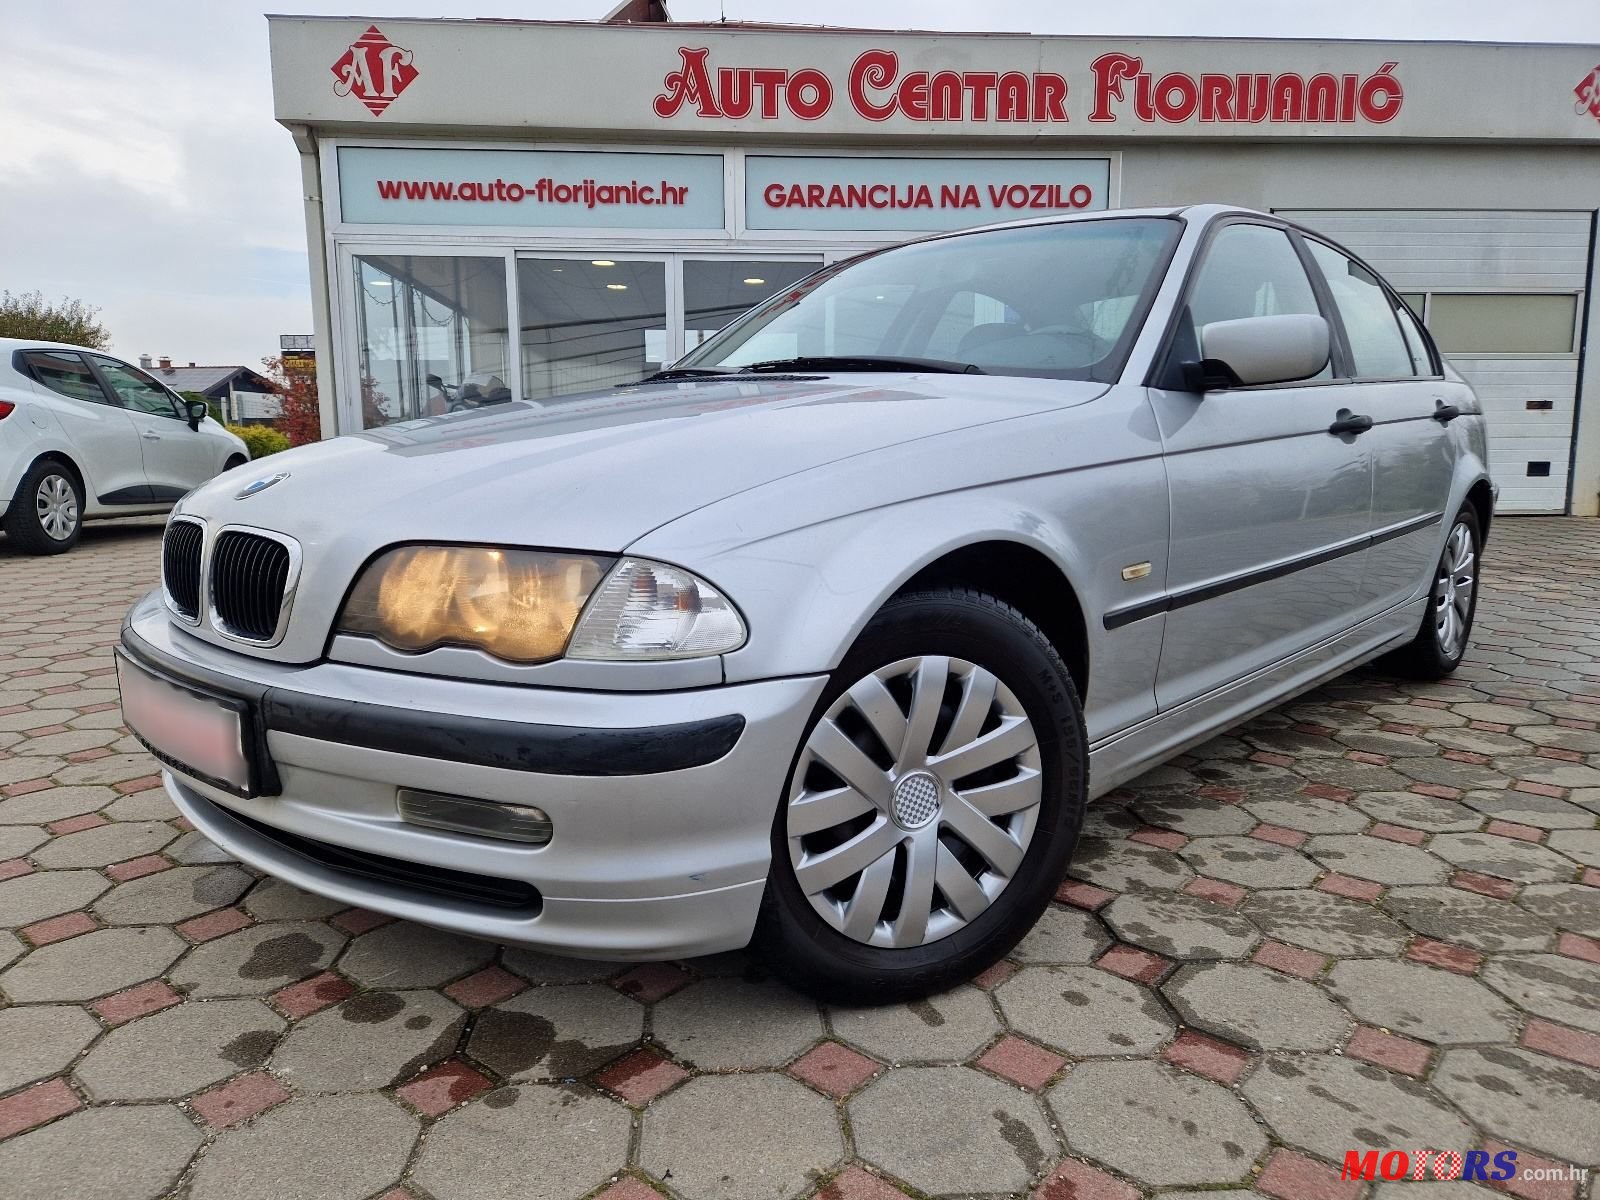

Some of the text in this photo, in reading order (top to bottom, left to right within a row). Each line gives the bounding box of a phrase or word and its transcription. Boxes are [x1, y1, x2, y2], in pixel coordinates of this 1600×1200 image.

[377, 178, 689, 210] www.auto-florijanic.hr
[763, 183, 1092, 209] GARANCIJA NA VOZILO
